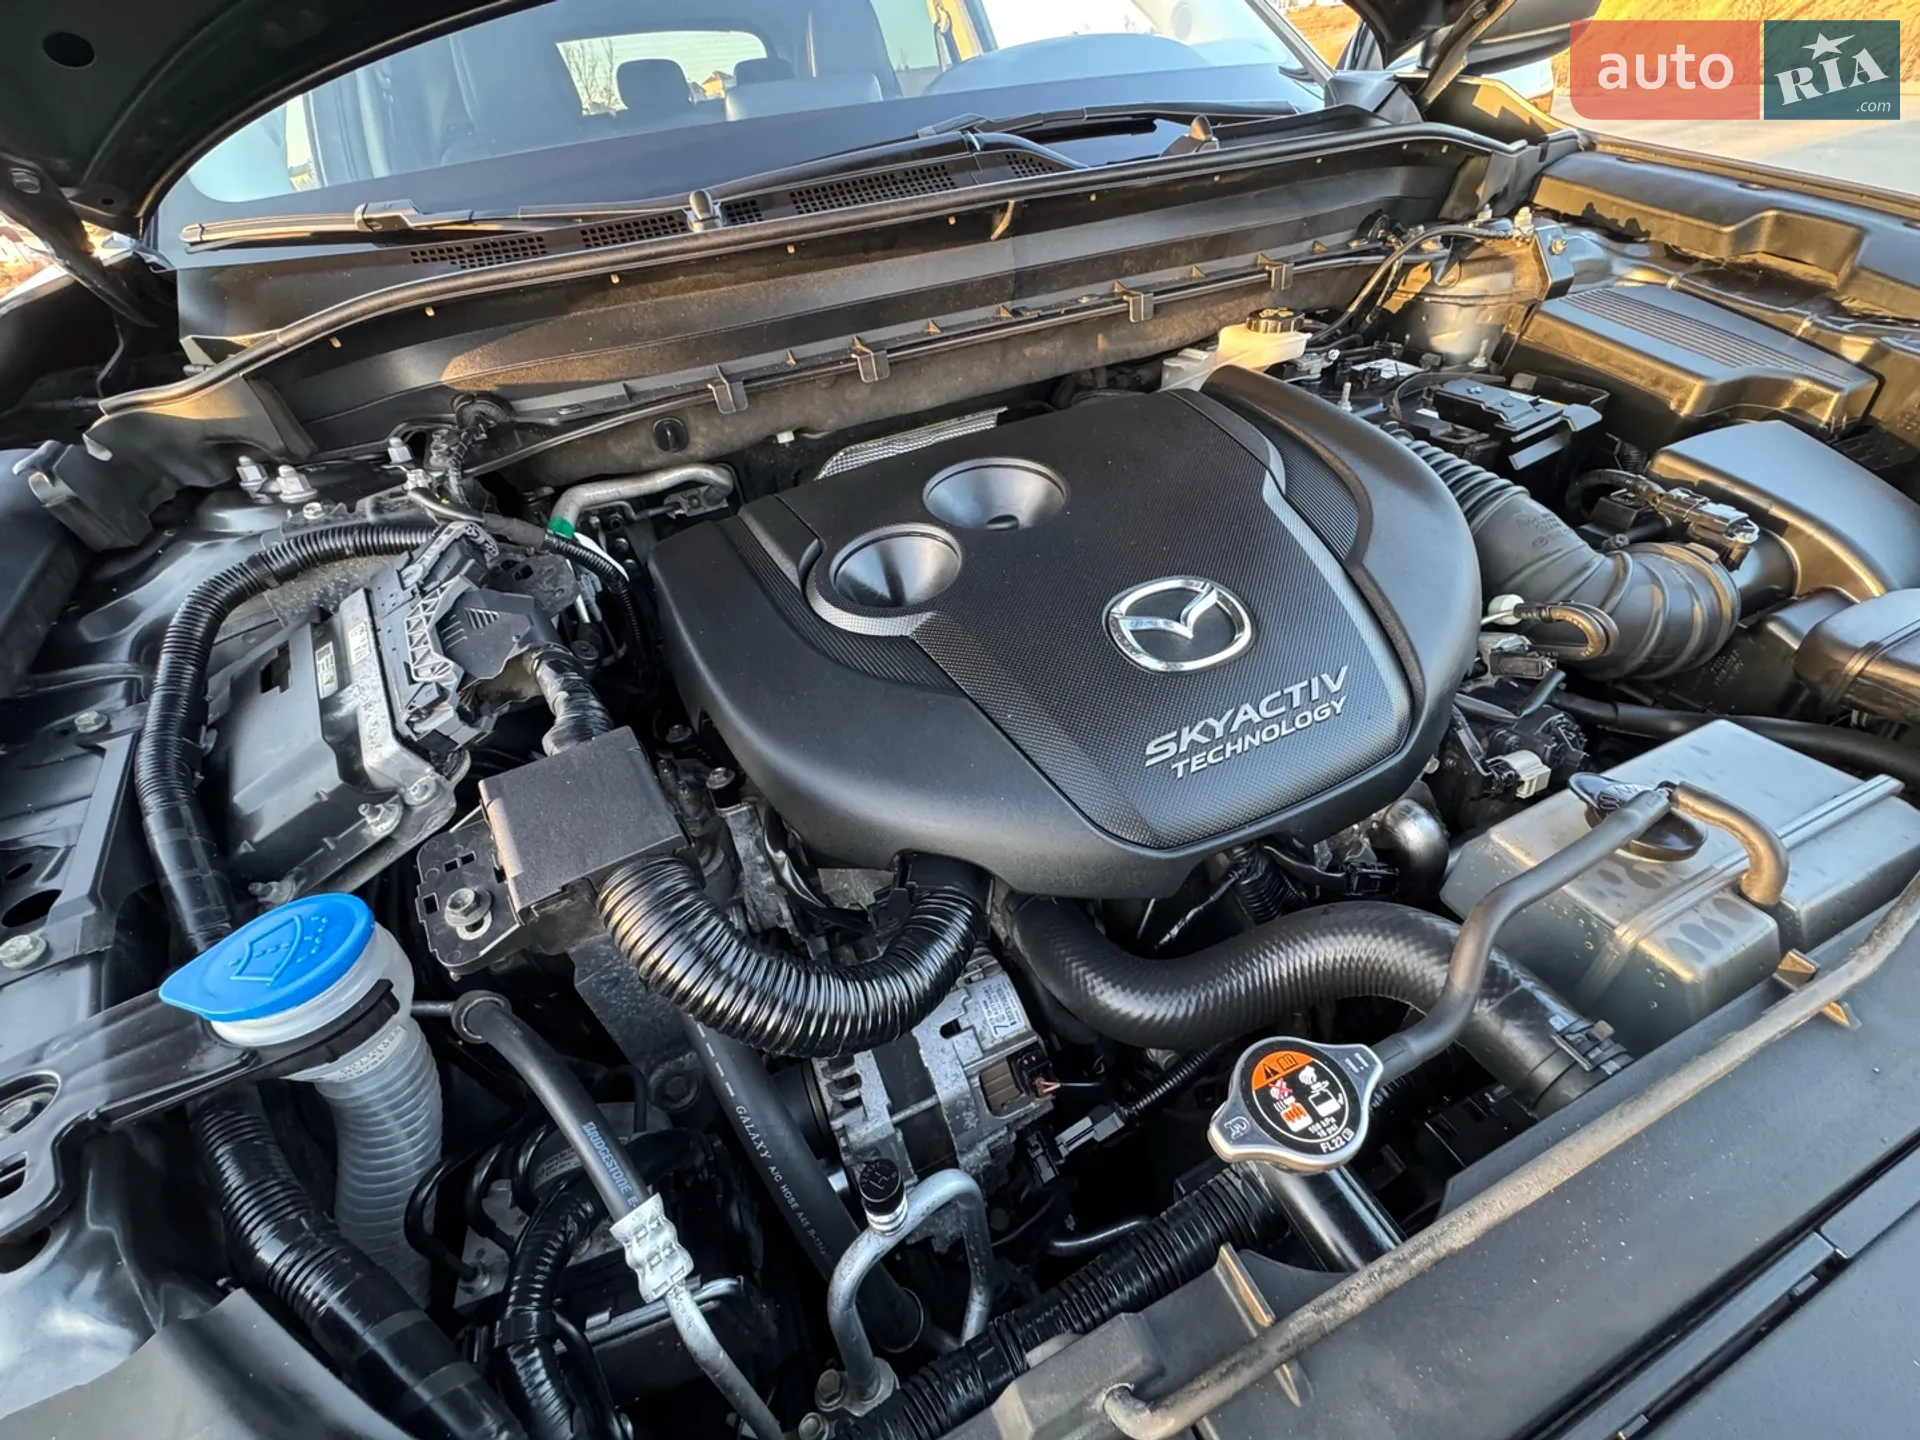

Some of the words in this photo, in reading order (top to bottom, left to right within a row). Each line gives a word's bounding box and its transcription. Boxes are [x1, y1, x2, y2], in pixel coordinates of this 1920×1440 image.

[1145, 665, 1348, 768] SKYACTIV
[1171, 695, 1346, 779] TECHNOLOGY
[582, 1121, 632, 1195] BRIDGESTONE
[735, 1104, 772, 1160] GALAXY
[768, 1165, 783, 1183] A/C
[780, 1183, 800, 1211] HOSE
[1320, 1135, 1346, 1153] FL22
